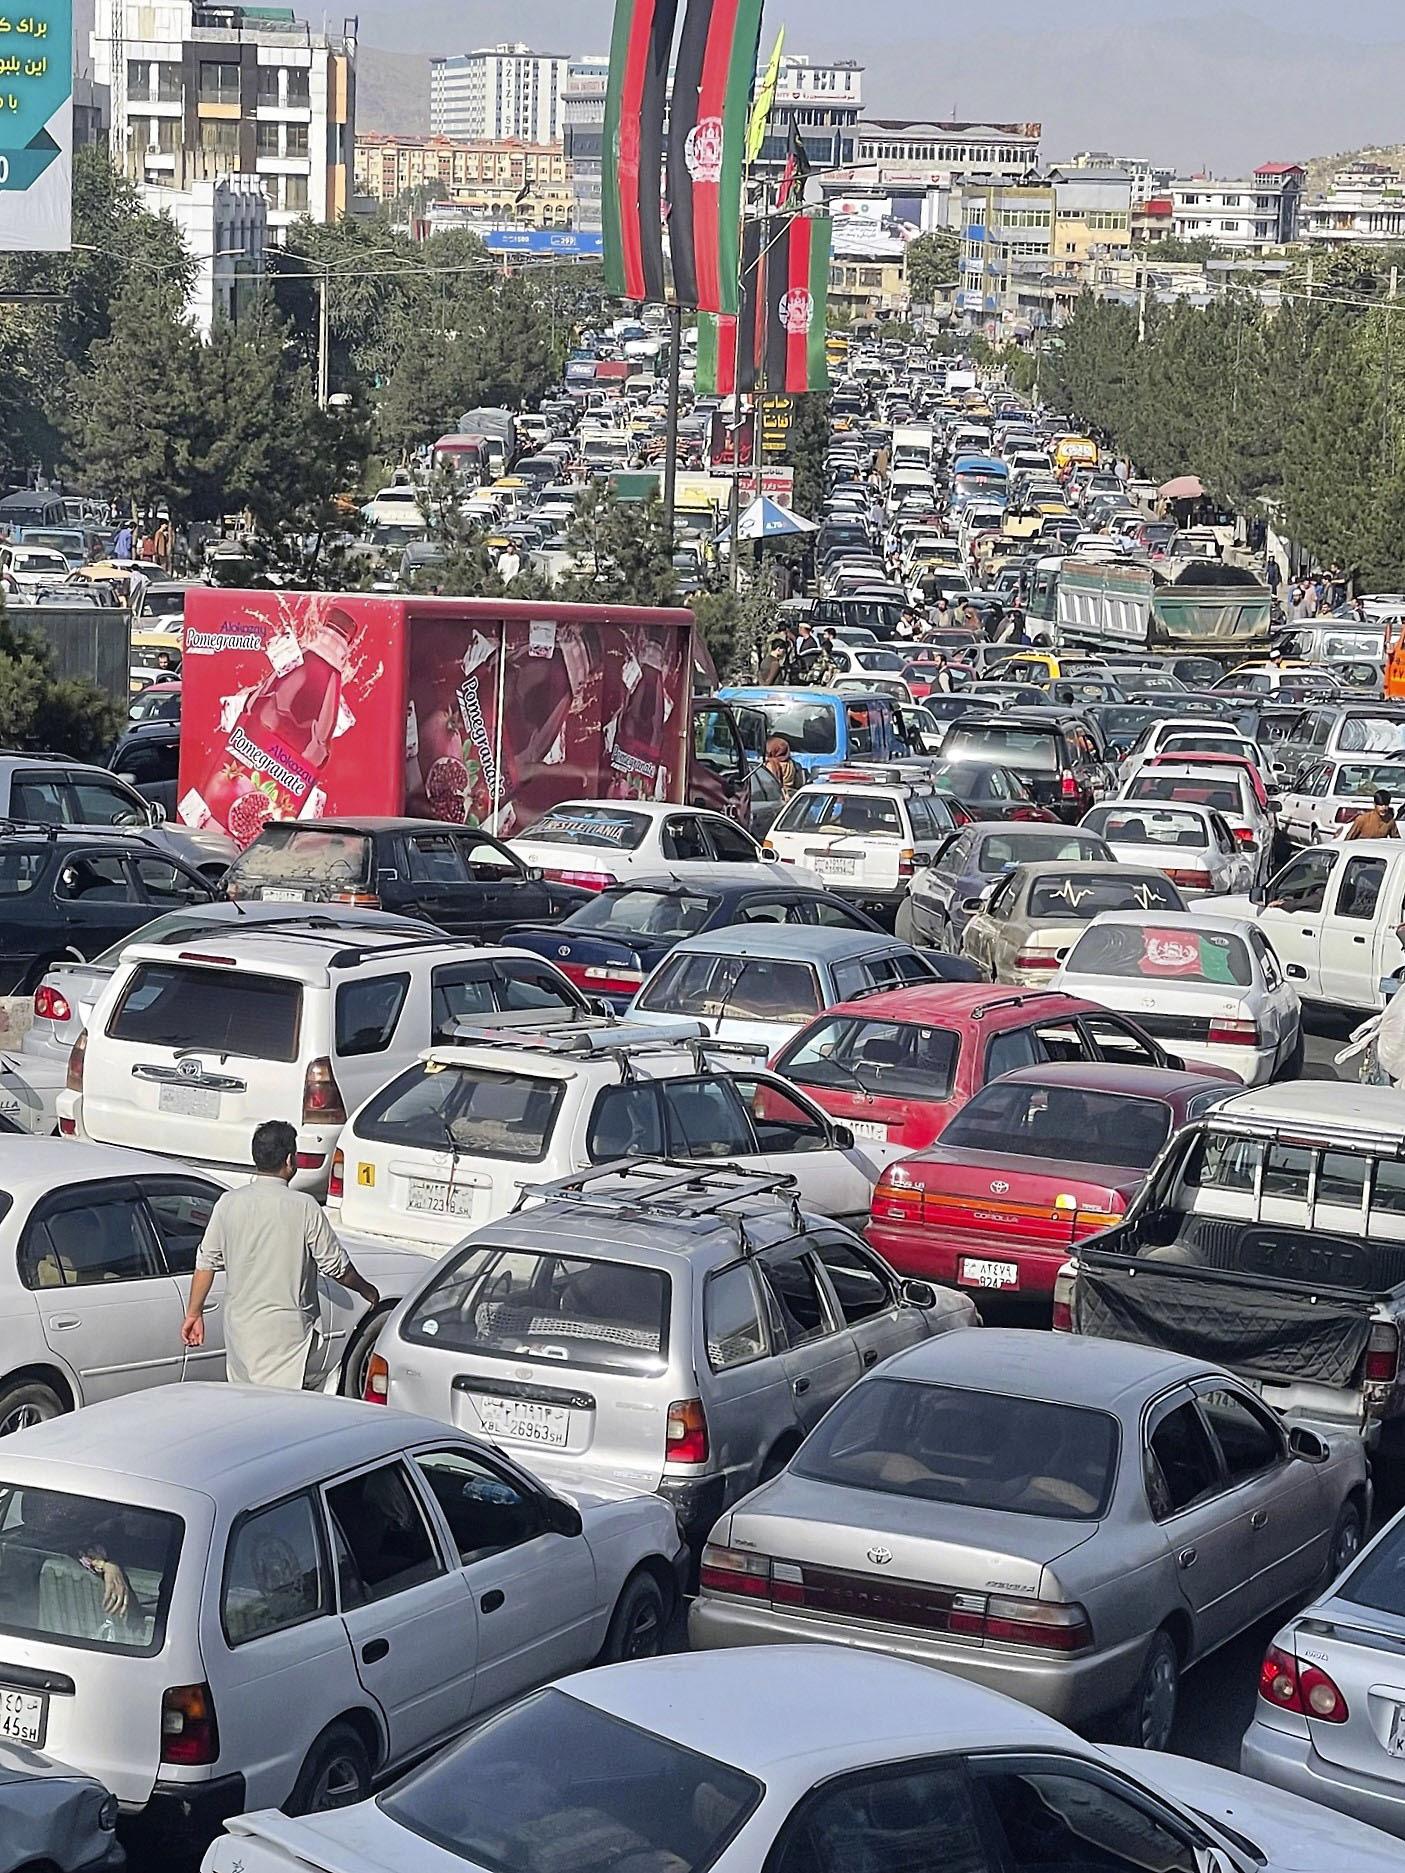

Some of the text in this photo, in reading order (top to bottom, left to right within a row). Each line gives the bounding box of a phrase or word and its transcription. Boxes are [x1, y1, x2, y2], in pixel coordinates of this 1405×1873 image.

[16, 18, 47, 38] برای
[25, 57, 47, 76] این
[9, 93, 18, 114] با
[187, 628, 262, 652] Pomegranate
[229, 726, 305, 796] Pomegranate
[362, 1166, 371, 1184] 1
